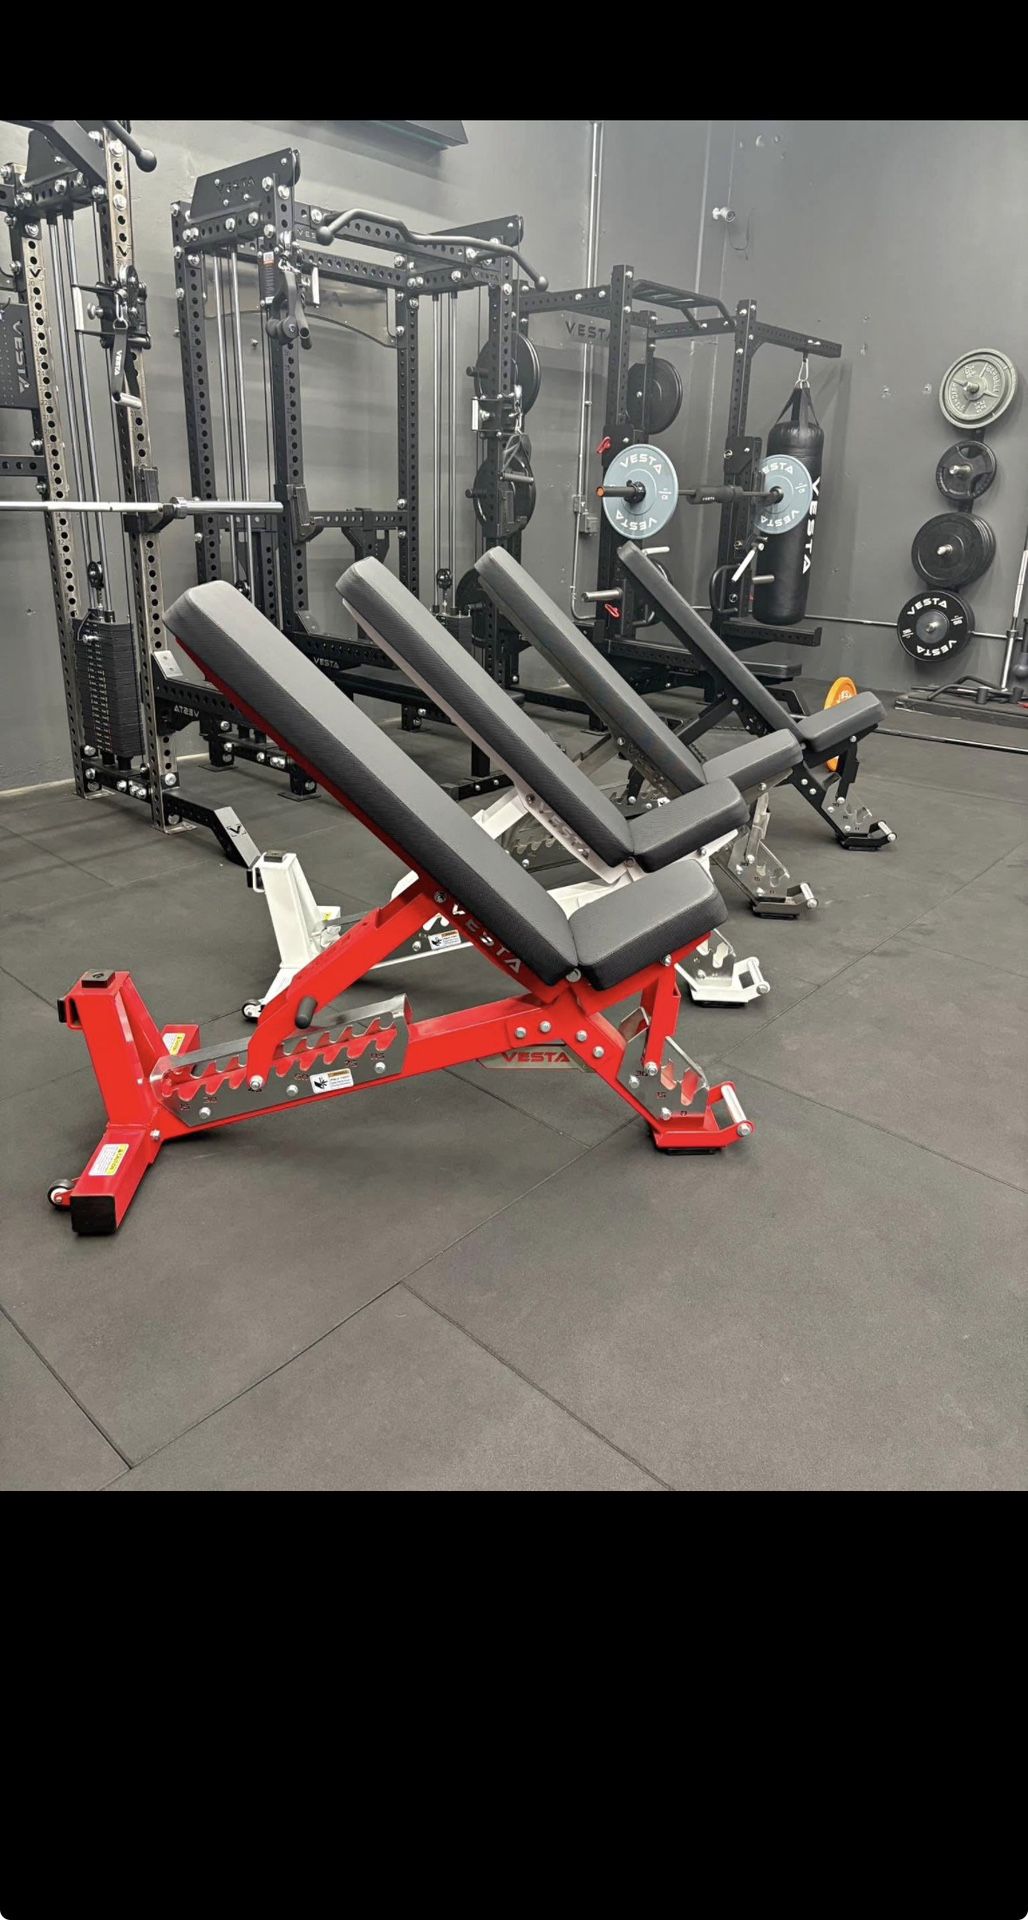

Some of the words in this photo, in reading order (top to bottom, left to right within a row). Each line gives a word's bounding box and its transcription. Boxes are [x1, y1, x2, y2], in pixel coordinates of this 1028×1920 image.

[12, 319, 30, 393] VESTA
[620, 454, 662, 474] VESTA
[759, 462, 793, 474] ESTA
[615, 509, 657, 530] VESTA
[760, 509, 800, 527] VESTA
[802, 476, 820, 574] VESTA
[907, 598, 947, 615] VESTA
[916, 640, 957, 656] VESTA
[313, 656, 340, 669] VESTA
[452, 904, 522, 974] VESTA
[501, 1051, 570, 1063] VESTA
